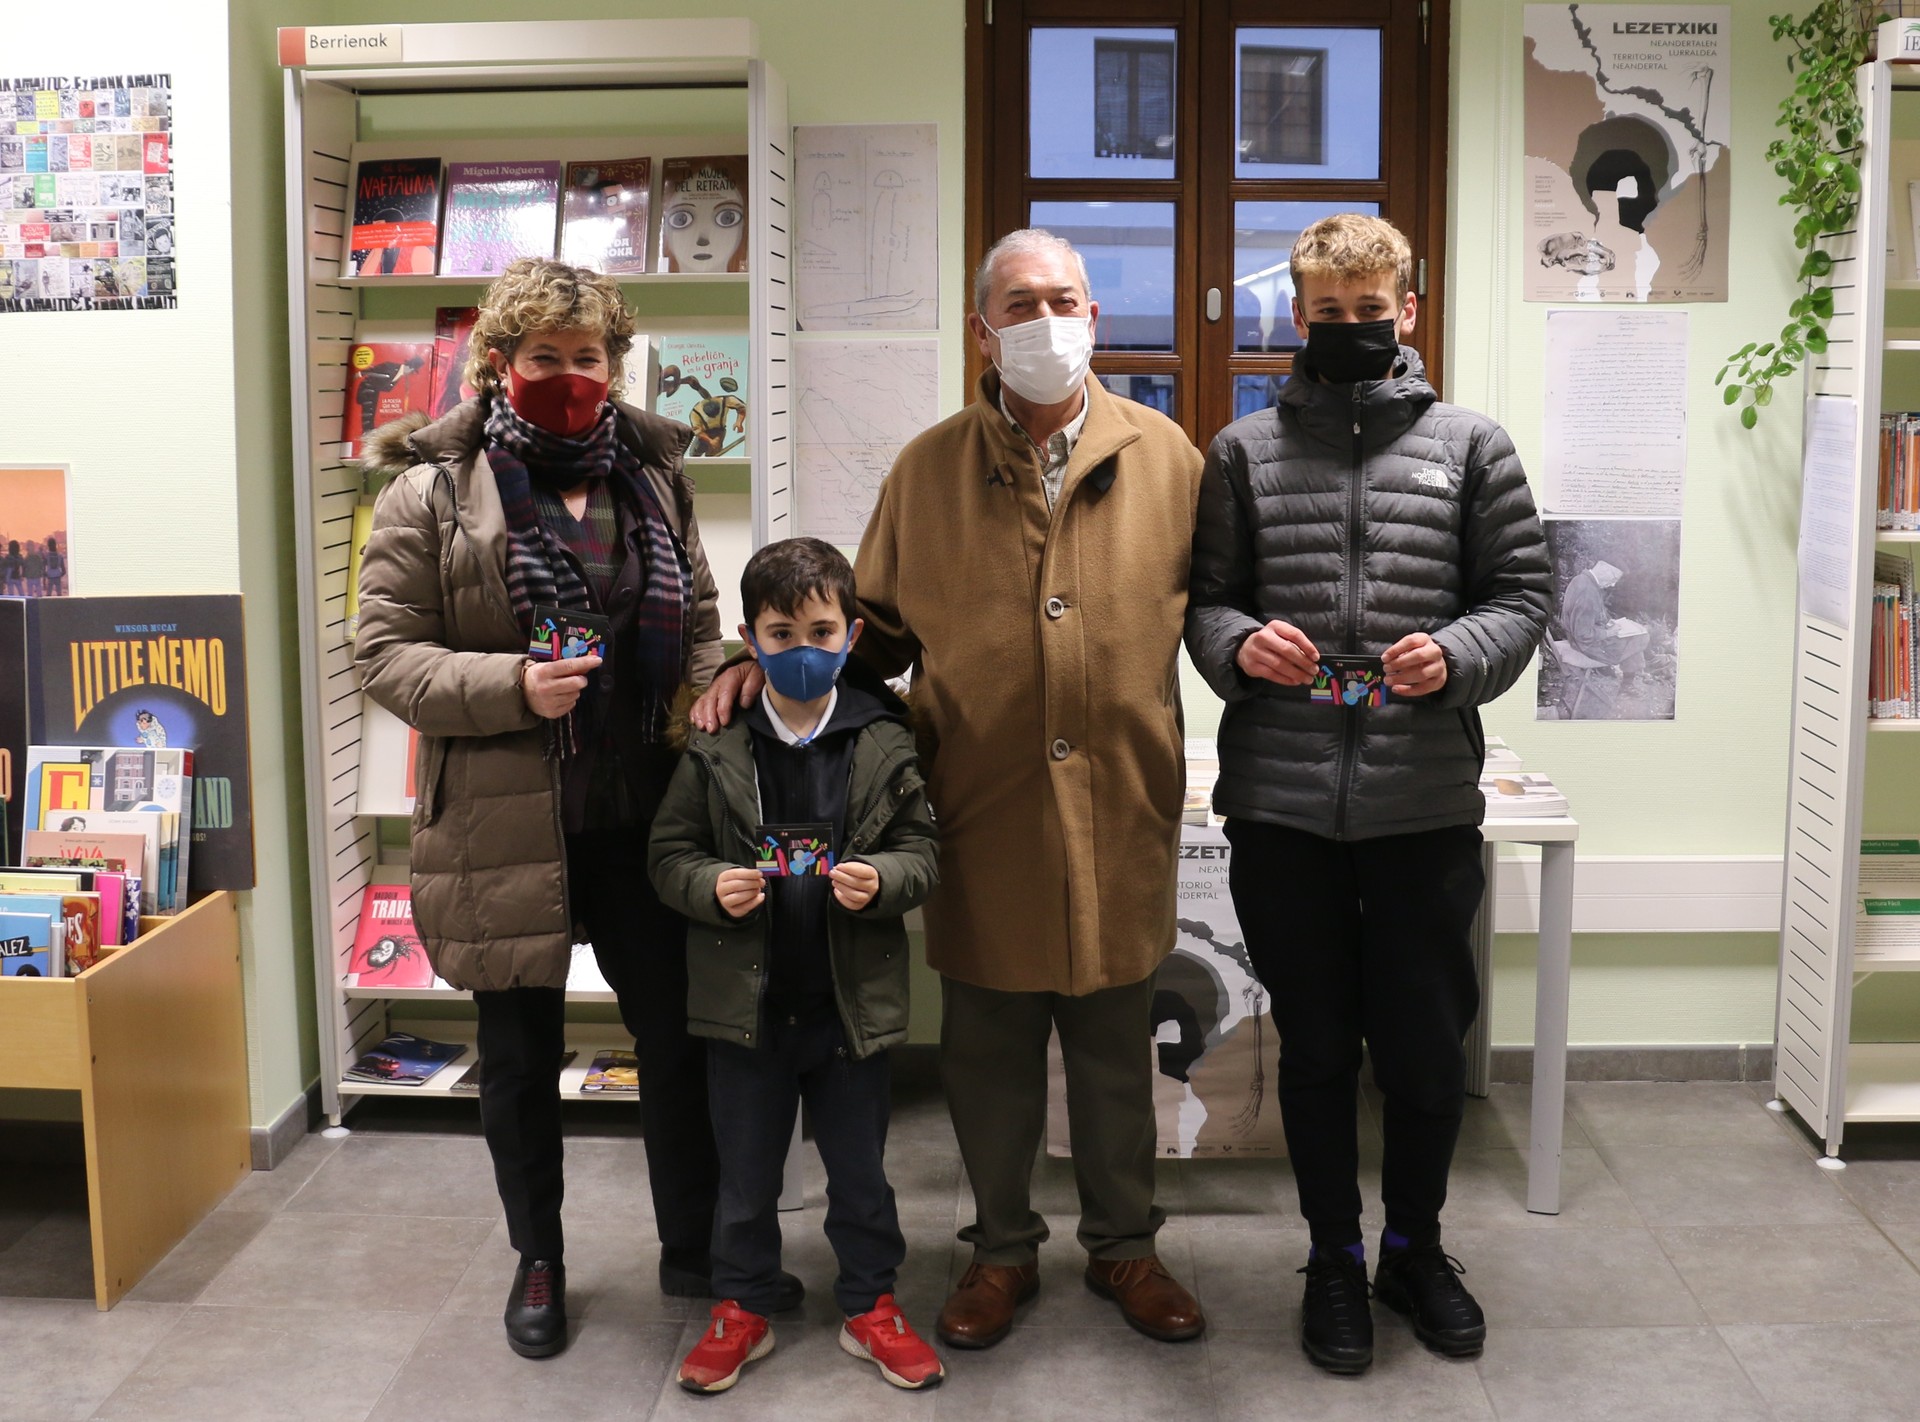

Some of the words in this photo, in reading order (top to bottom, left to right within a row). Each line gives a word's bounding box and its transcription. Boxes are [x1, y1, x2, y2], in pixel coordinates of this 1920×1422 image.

[1613, 22, 1718, 35] LEZETXIKI
[310, 32, 388, 49] Berrienak
[1650, 40, 1718, 48] NEANDERTALEN
[1612, 53, 1663, 61] TERRITORIO
[1668, 49, 1718, 57] LURRALDEA
[1612, 62, 1669, 71] NEANDERTAL
[463, 166, 500, 177] Miguel
[501, 166, 545, 176] Noguera
[359, 174, 436, 200] NAFTALINA
[696, 180, 737, 192] RETRATO
[682, 350, 725, 367] Rebelión
[703, 356, 739, 379] granja
[1411, 472, 1437, 481] NORTH
[1422, 468, 1437, 476] THE
[1418, 479, 1438, 487] FACE
[115, 624, 149, 634] WINSOR
[70, 640, 145, 734] LITTLE
[147, 634, 227, 717] NEMO
[194, 777, 234, 829] AND
[1180, 881, 1213, 890] TORIO
